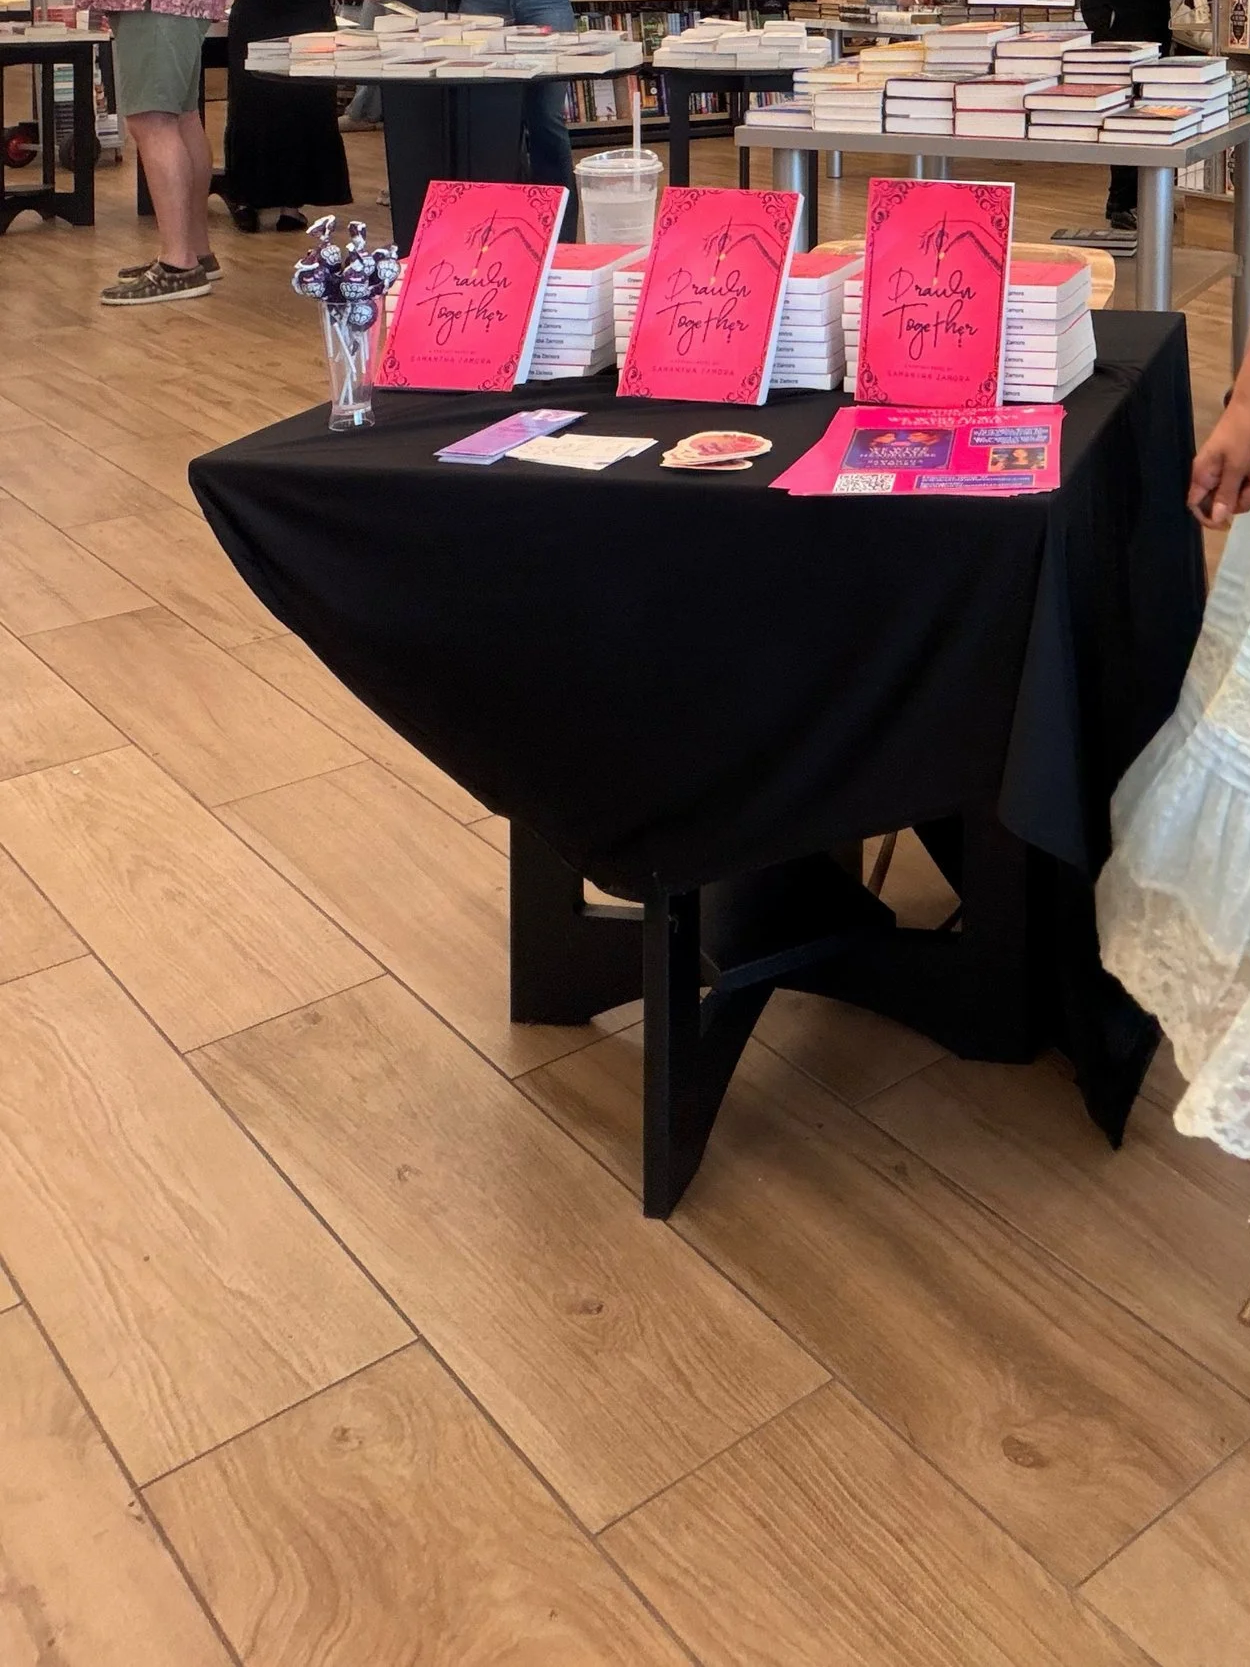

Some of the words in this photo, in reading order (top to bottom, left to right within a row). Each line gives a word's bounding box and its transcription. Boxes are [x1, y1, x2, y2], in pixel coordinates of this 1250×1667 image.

[425, 259, 512, 292] Drawn
[665, 268, 751, 300] Drawn
[888, 267, 976, 303] Drawn
[416, 288, 508, 346] Together
[656, 297, 749, 356] Together
[883, 299, 978, 360] Together
[887, 370, 932, 381] SAMANTHA
[936, 371, 970, 382] ZAMORA
